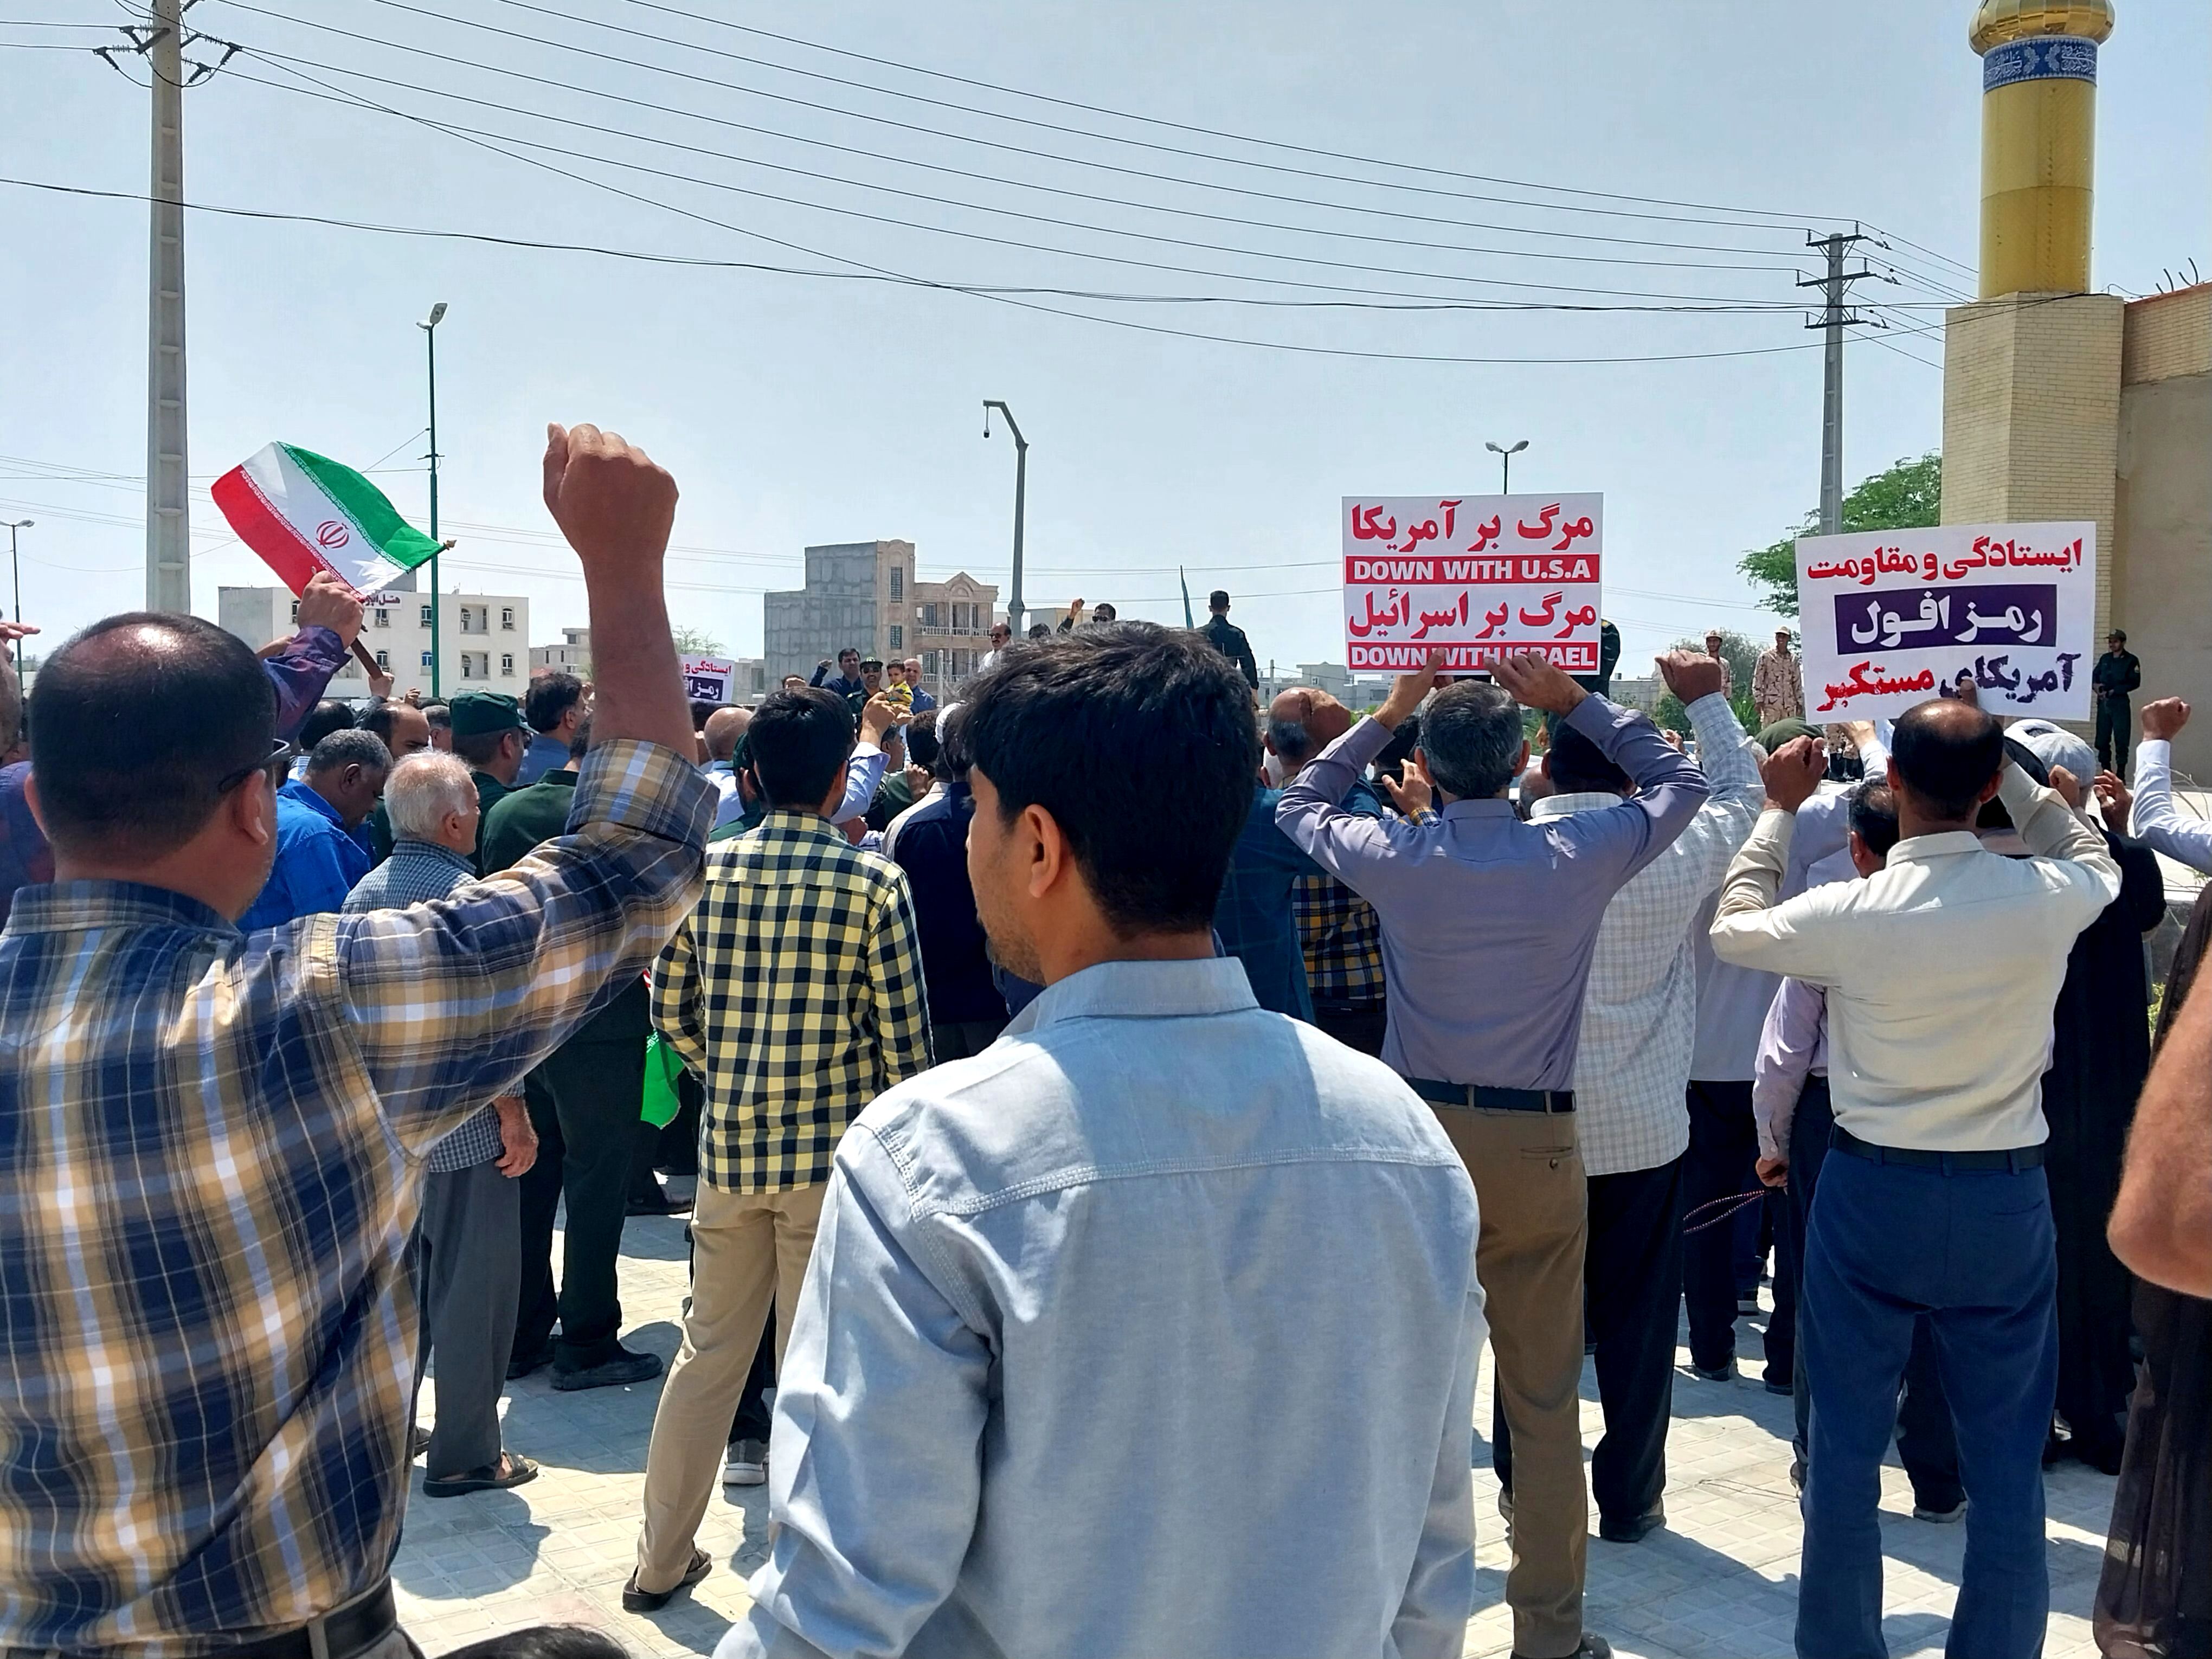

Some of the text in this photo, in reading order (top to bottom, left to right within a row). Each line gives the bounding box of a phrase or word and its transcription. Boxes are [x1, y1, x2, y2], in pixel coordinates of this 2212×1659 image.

[1351, 500, 1593, 552] مرگ بر آمریکا
[1354, 560, 1591, 580] DOWN WITH U.S.A
[1808, 536, 2082, 586] ایستادگی و مقاومت
[1349, 588, 1597, 639] مرگ بر اسرائیل
[1851, 590, 2042, 647] رمز افول
[691, 660, 731, 677] ایستادگی
[1352, 647, 1427, 666] DOWN
[1431, 647, 1500, 666] WITH
[693, 681, 719, 699] رمز
[1816, 660, 1935, 712] مستکبر
